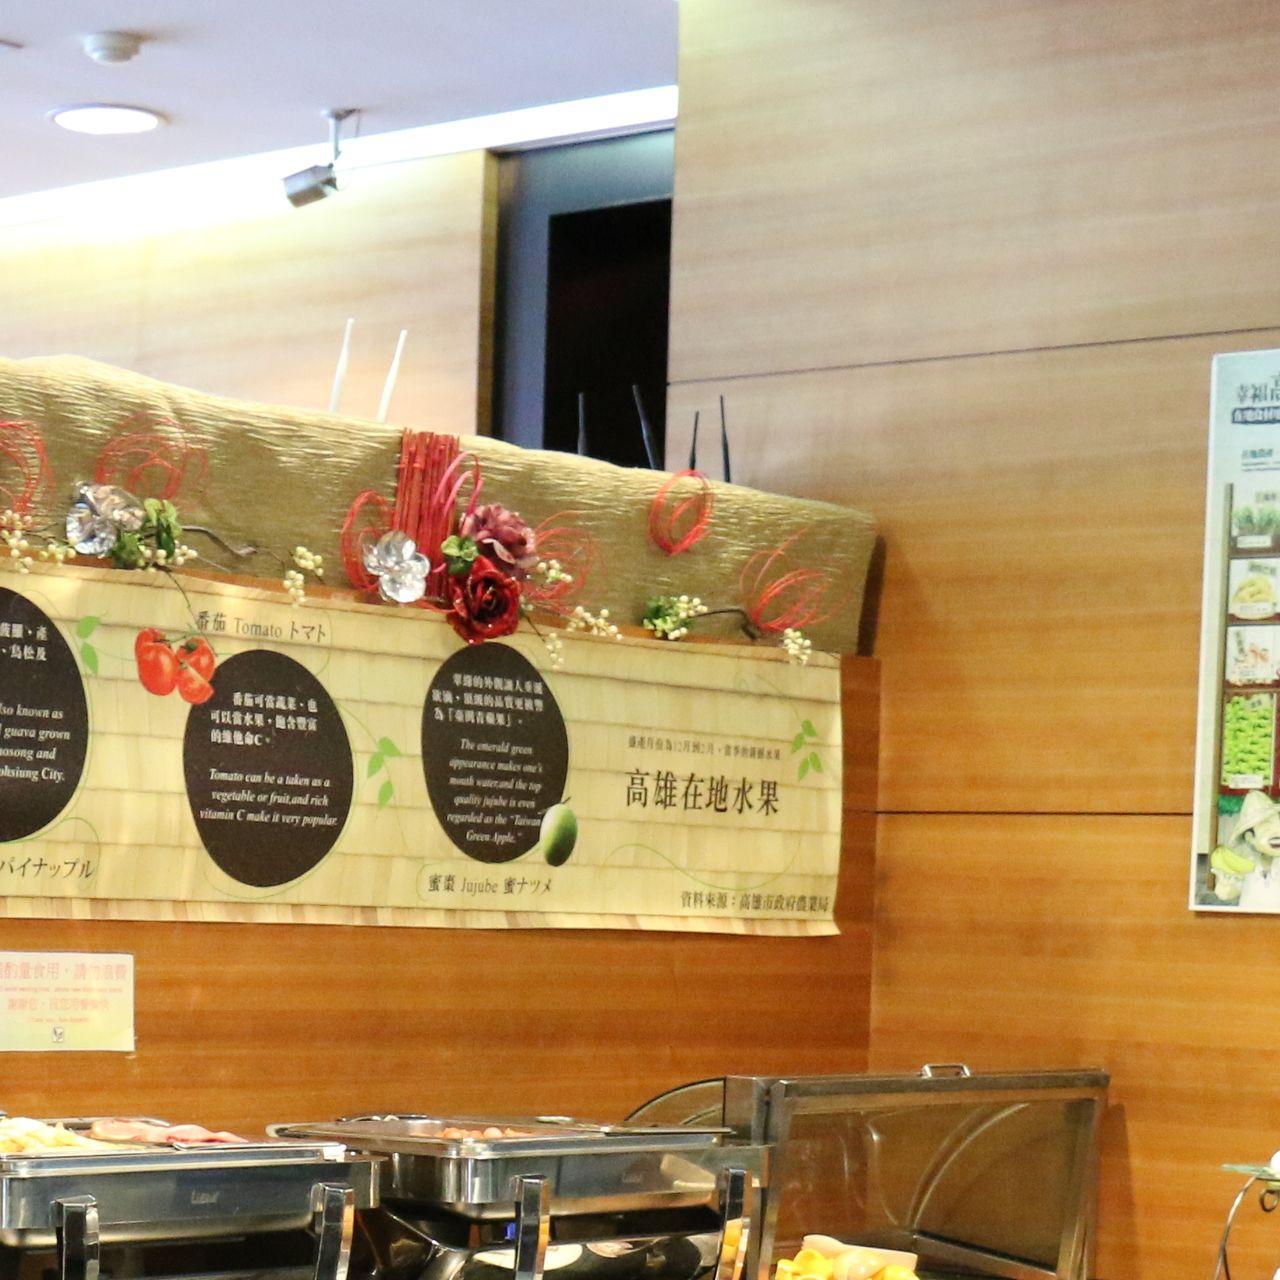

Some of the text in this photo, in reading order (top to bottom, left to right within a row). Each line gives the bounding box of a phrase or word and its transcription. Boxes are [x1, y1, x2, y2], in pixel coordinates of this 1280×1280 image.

[197, 610, 327, 643] 番茄 Tomato トマト
[16, 703, 50, 719] known
[51, 708, 64, 720] as
[4, 726, 36, 741] guava
[38, 728, 71, 742] grown
[36, 747, 57, 761] and
[41, 766, 66, 784] City.
[209, 768, 331, 788] Tomato can be a taken as a
[211, 789, 257, 804] vegetable
[257, 793, 268, 802] or
[310, 794, 329, 807] rich
[625, 768, 779, 816] 高雄在地水果
[200, 807, 234, 820] vitamin
[236, 809, 245, 821] C
[246, 809, 270, 823] make
[272, 810, 280, 823] it
[281, 814, 300, 825] very
[461, 877, 498, 897] Jujube
